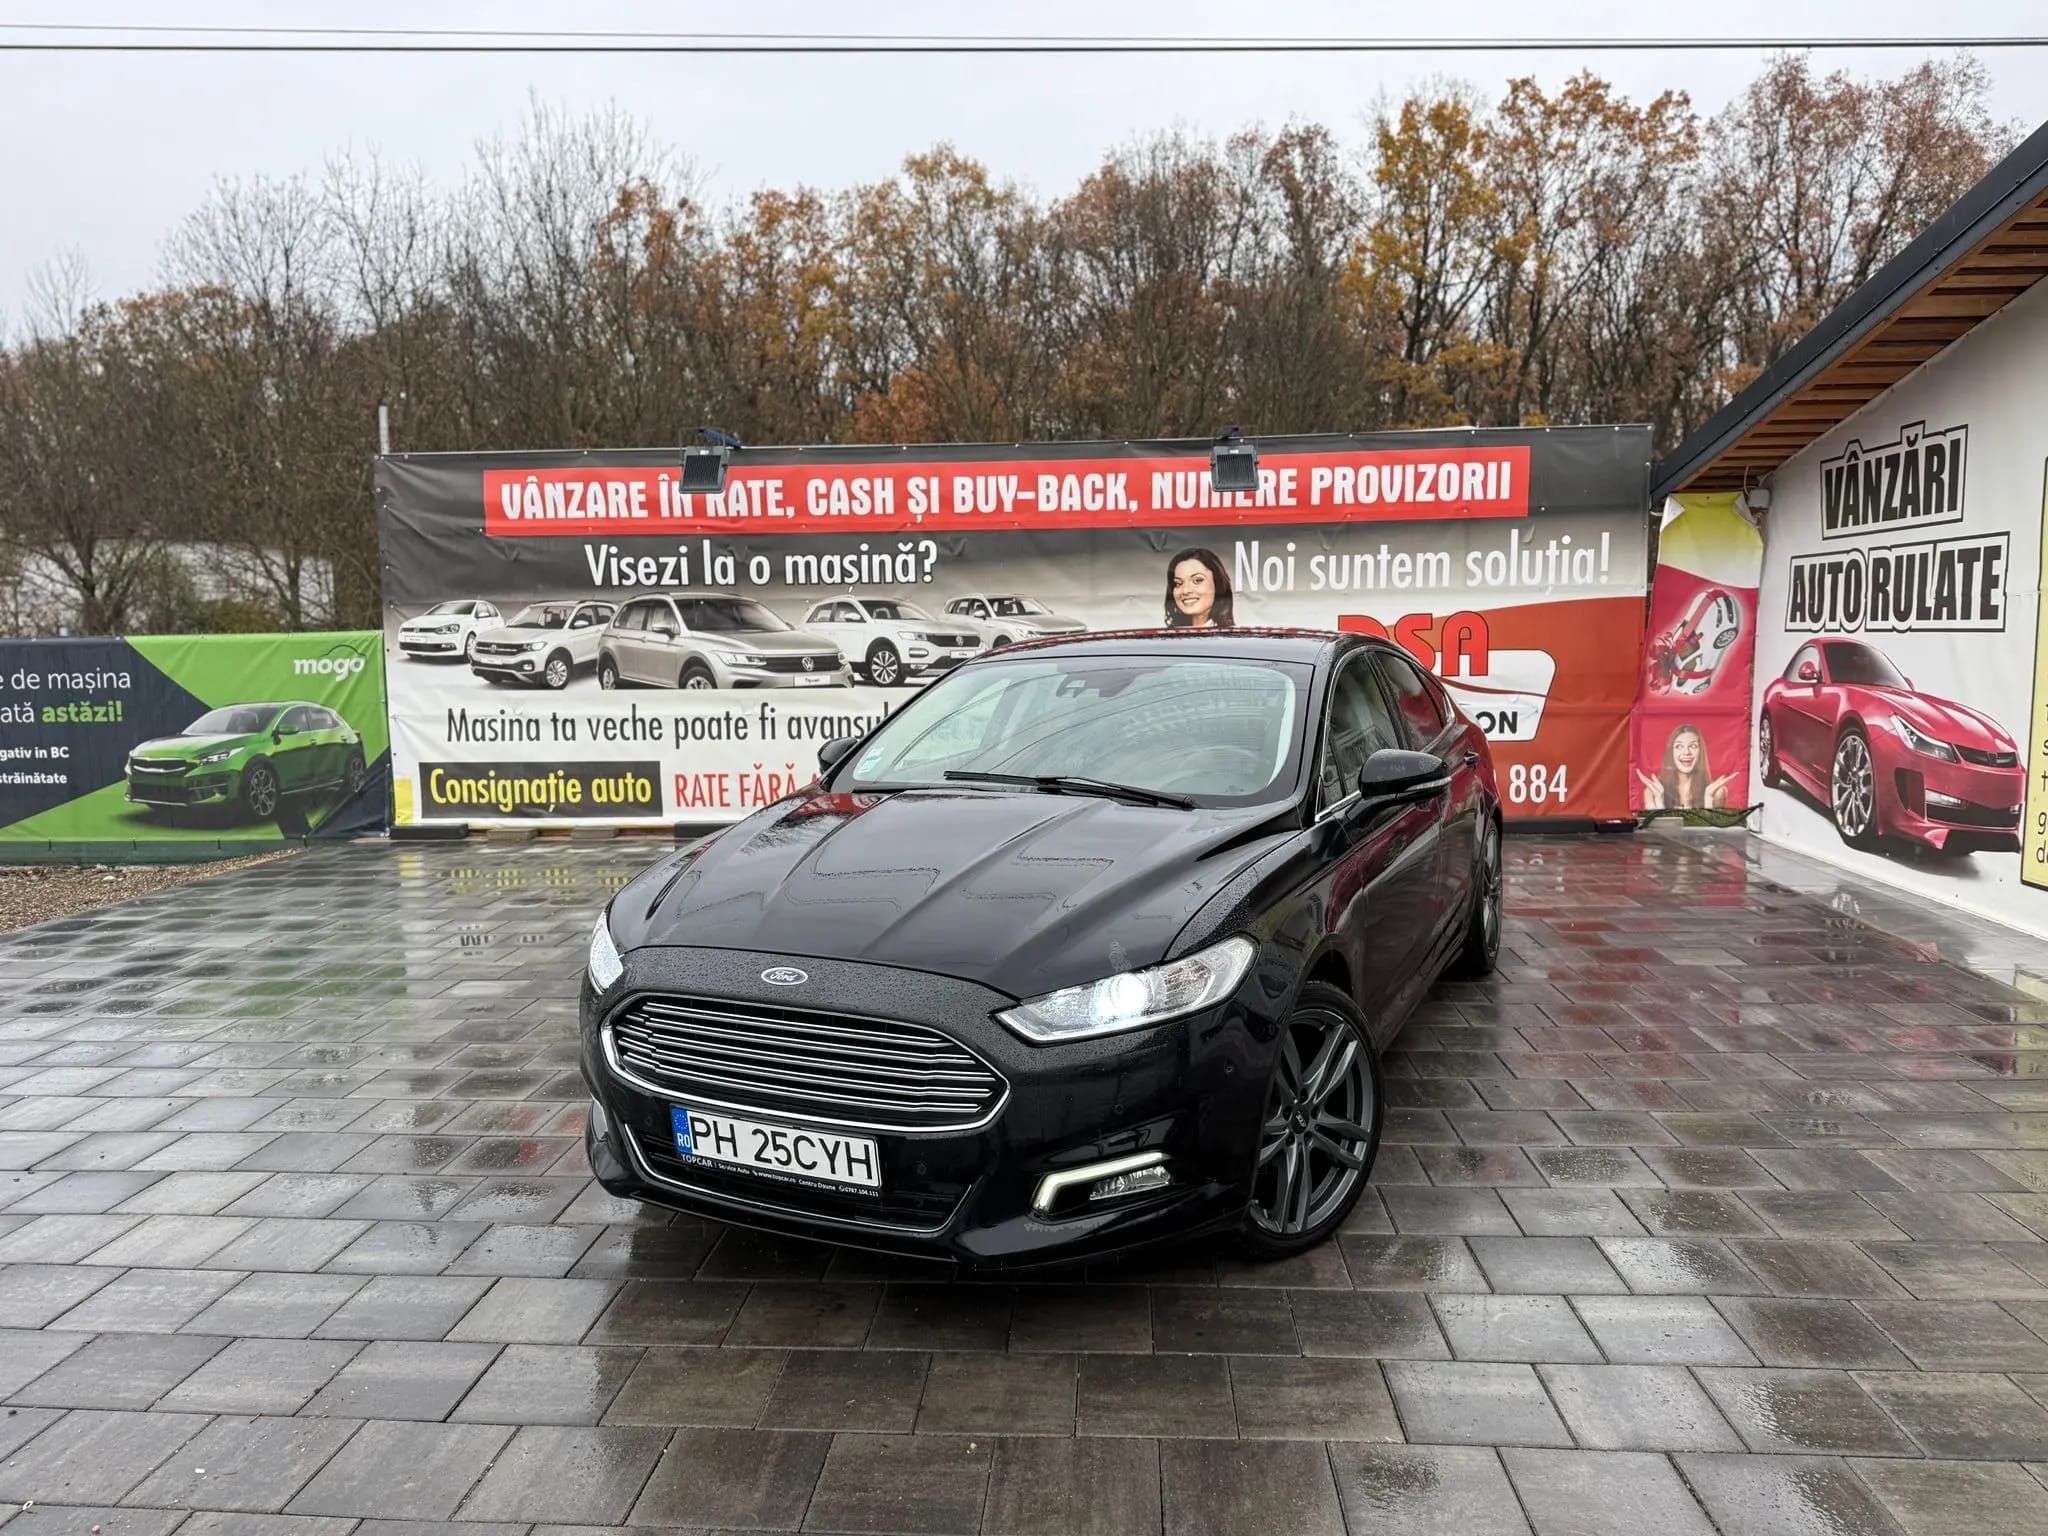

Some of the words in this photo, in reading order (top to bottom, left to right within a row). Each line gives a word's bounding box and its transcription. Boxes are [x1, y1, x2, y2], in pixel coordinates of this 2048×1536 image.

[502, 475, 648, 519] VÂNZARE
[658, 473, 693, 517] ÎN
[706, 480, 794, 519] RATE,
[806, 477, 895, 515] CASH
[907, 476, 940, 523] ȘI
[1311, 461, 1511, 505] PROVIZORII
[1825, 433, 1961, 530] VÂNZĂRI
[584, 543, 689, 587] Visezi
[702, 539, 736, 586] la
[750, 555, 771, 585] o
[785, 540, 937, 593] mașină?
[1234, 541, 1297, 592] Noi
[1310, 544, 1450, 591] suntem
[1466, 528, 1610, 595] soluția!
[1789, 558, 1864, 624] AUTO
[1870, 545, 2002, 623] RULATE
[11, 668, 41, 690] de
[48, 667, 131, 695] mașina
[294, 657, 365, 682] mogo
[42, 700, 123, 722] astăzi!
[447, 707, 541, 742] Masina
[550, 712, 576, 742] ta
[587, 703, 663, 741] veche
[674, 711, 748, 749] poate
[758, 702, 777, 740] fi
[34, 747, 48, 759] in
[50, 746, 70, 759] BC
[430, 768, 582, 813] Consignație
[591, 772, 652, 803] auto
[674, 773, 731, 808] RATE
[738, 762, 797, 808] FĂRĂ
[1509, 764, 1568, 803] 884
[677, 1133, 691, 1148] RO
[681, 1154, 713, 1168] TOPCAR
[689, 1116, 738, 1158] PH
[752, 1128, 873, 1179] 25CYH
